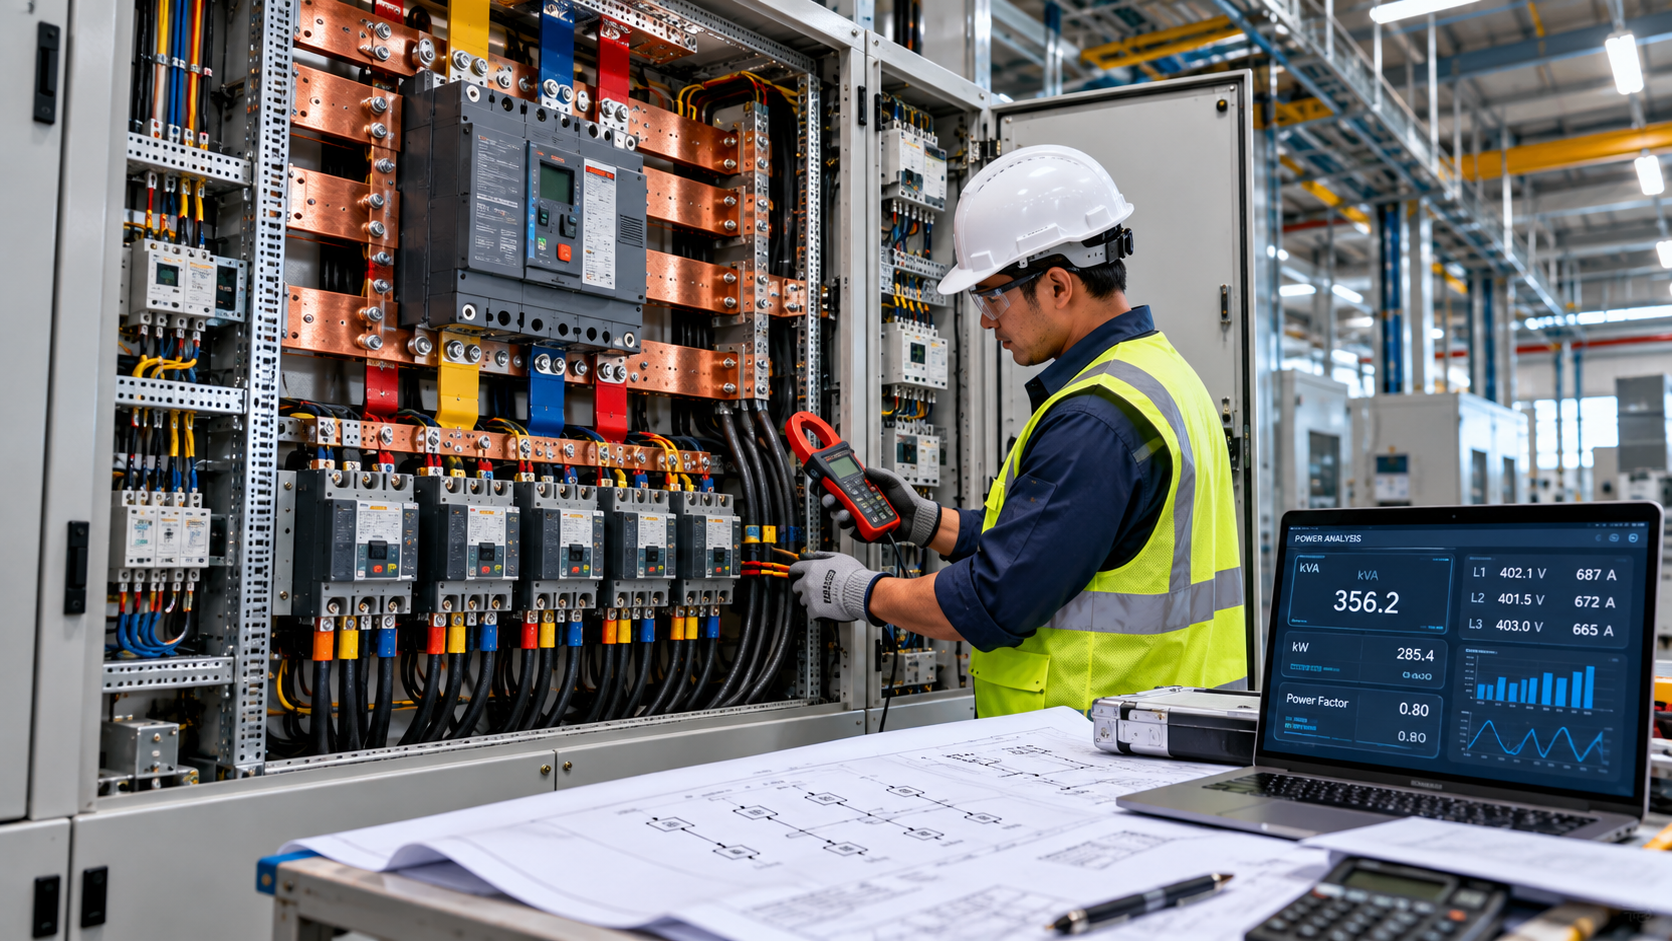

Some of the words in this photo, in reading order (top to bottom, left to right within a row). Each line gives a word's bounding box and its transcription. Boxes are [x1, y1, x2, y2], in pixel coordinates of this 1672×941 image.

[1294, 534, 1323, 543] POWER
[1299, 562, 1320, 573] kVA
[1357, 569, 1379, 581] kVA
[1473, 566, 1486, 578] L1
[1499, 566, 1533, 579] 402.1
[1537, 567, 1547, 580] V
[1575, 568, 1602, 581] 687
[1606, 568, 1618, 581] A
[1334, 590, 1399, 613] 356.2
[1470, 592, 1485, 604] L2
[1497, 592, 1532, 606] 401.5
[1535, 594, 1546, 606] V
[1574, 595, 1600, 609] 672
[1604, 596, 1616, 609] A
[1468, 618, 1483, 630] L3
[1495, 619, 1531, 632] 403.0
[1534, 621, 1544, 633] V
[1572, 622, 1599, 637] 665
[1603, 624, 1614, 637] A
[1292, 641, 1310, 653] kW
[1396, 647, 1435, 662] 285.4
[1286, 692, 1316, 705] Power
[1318, 695, 1350, 709] Factor
[1399, 701, 1430, 717] 0.80
[1397, 730, 1427, 744] 0.80
